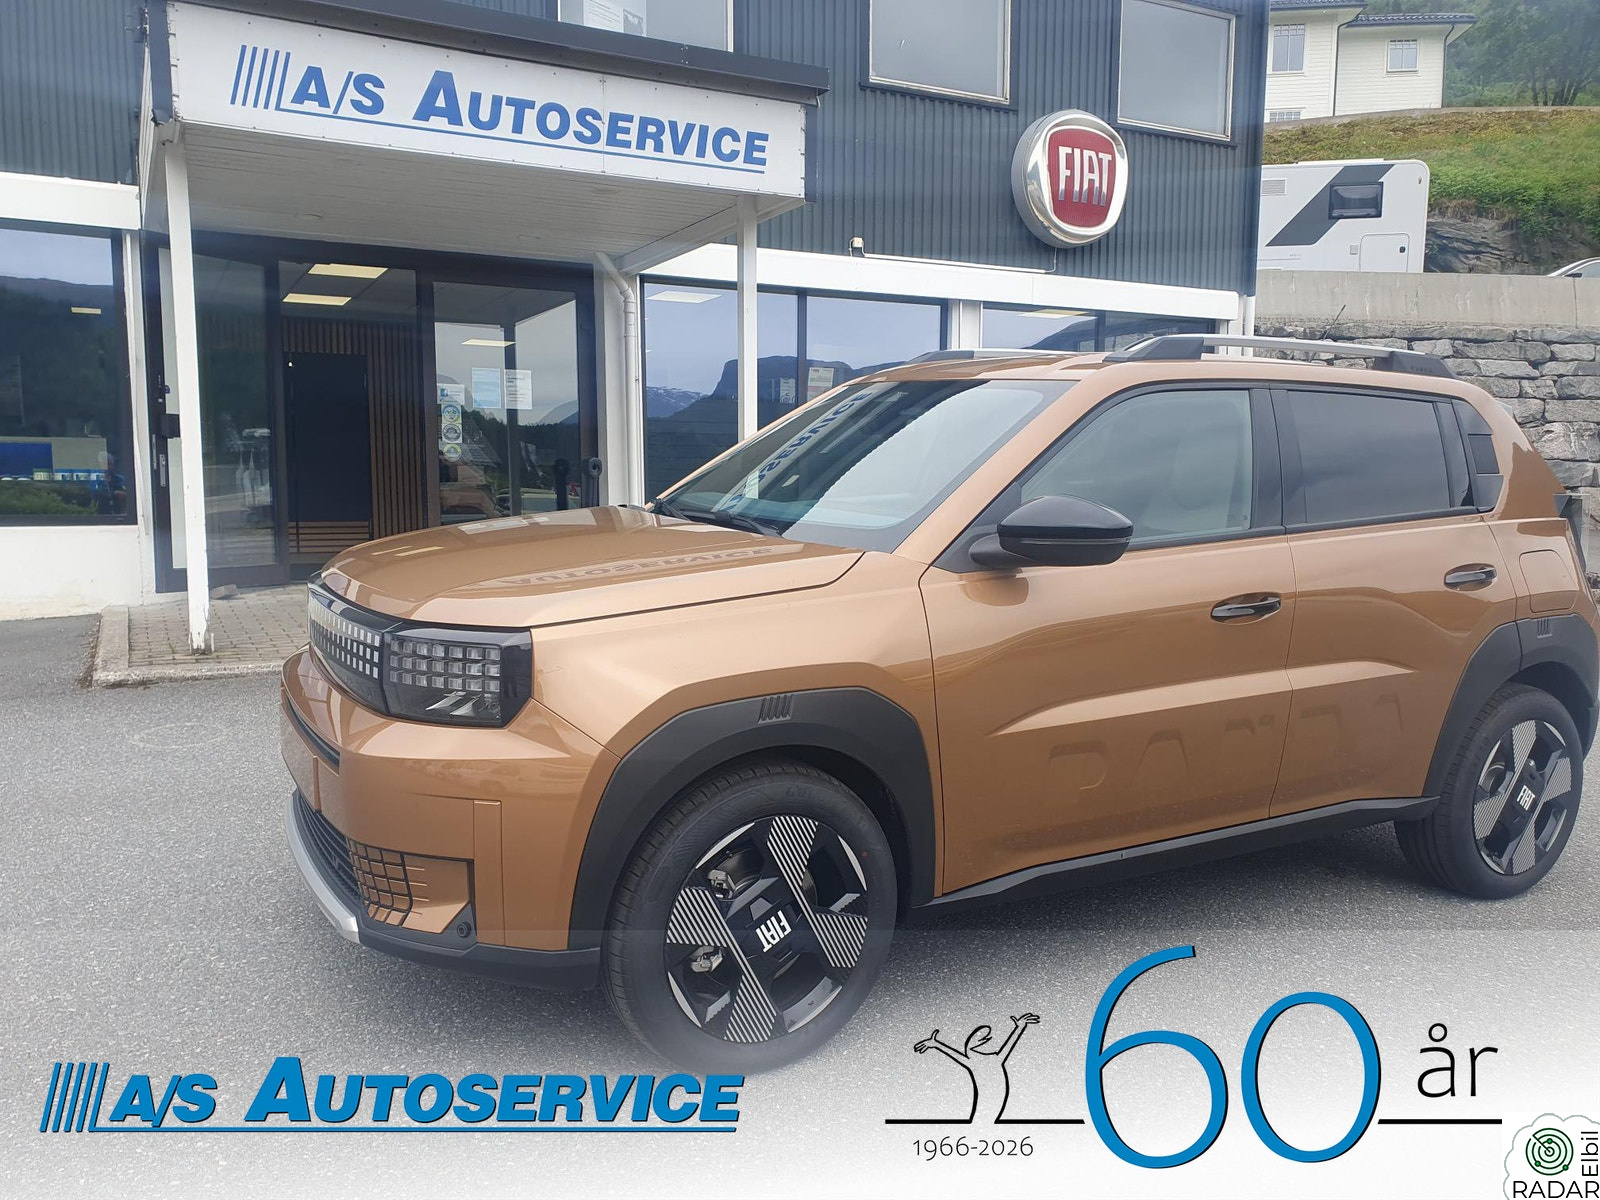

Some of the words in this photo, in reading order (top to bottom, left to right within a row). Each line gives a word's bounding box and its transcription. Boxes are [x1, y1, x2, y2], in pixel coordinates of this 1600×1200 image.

[290, 65, 386, 116] A/S
[411, 69, 770, 167] AUTOSERVICE
[1058, 145, 1112, 207] FIAT
[1516, 784, 1536, 811] FIAT
[755, 909, 792, 953] FIAT
